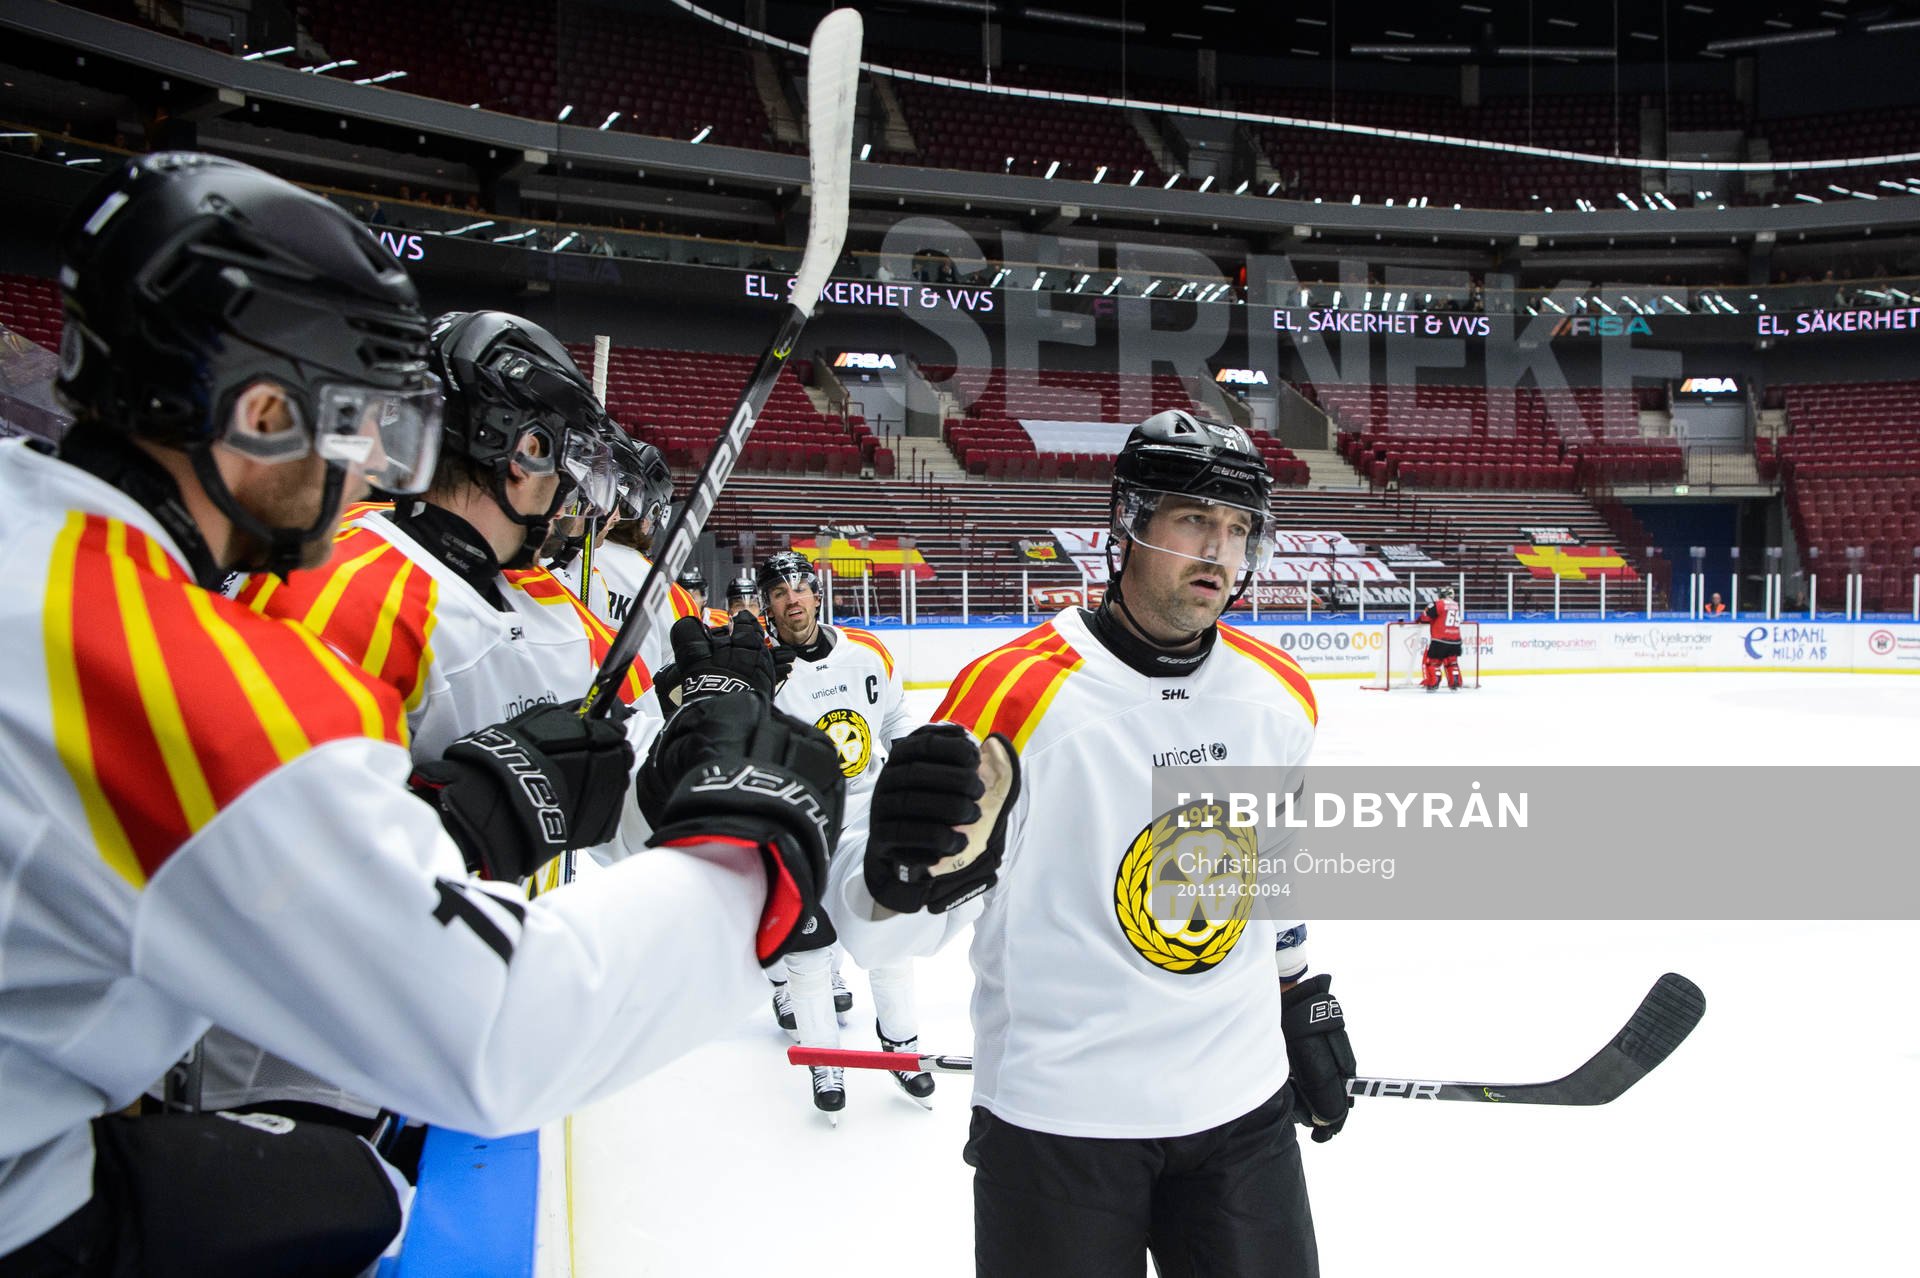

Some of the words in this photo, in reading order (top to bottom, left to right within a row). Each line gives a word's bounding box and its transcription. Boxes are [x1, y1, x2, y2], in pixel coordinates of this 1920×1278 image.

[745, 274, 779, 300] EL,
[786, 277, 912, 308] SKERHET
[920, 287, 941, 309] &
[946, 289, 994, 312] VVS
[878, 216, 1689, 446] SERNEKE
[1273, 310, 1302, 333] EL,
[1308, 308, 1418, 334] SÄKERHET
[1424, 314, 1443, 335] &
[1449, 316, 1491, 336] VVS
[1758, 315, 1789, 337] EL,
[1796, 308, 1920, 334] SÄKERHET
[1223, 437, 1239, 451] 21
[1773, 626, 1828, 644] EKDAHL
[1511, 637, 1597, 652] montagepunkten
[1809, 646, 1828, 661] AB
[811, 686, 839, 701] unicef
[865, 674, 879, 705] C
[1161, 688, 1190, 701] SHL
[827, 710, 848, 723] 1912
[1153, 743, 1209, 768] unicef
